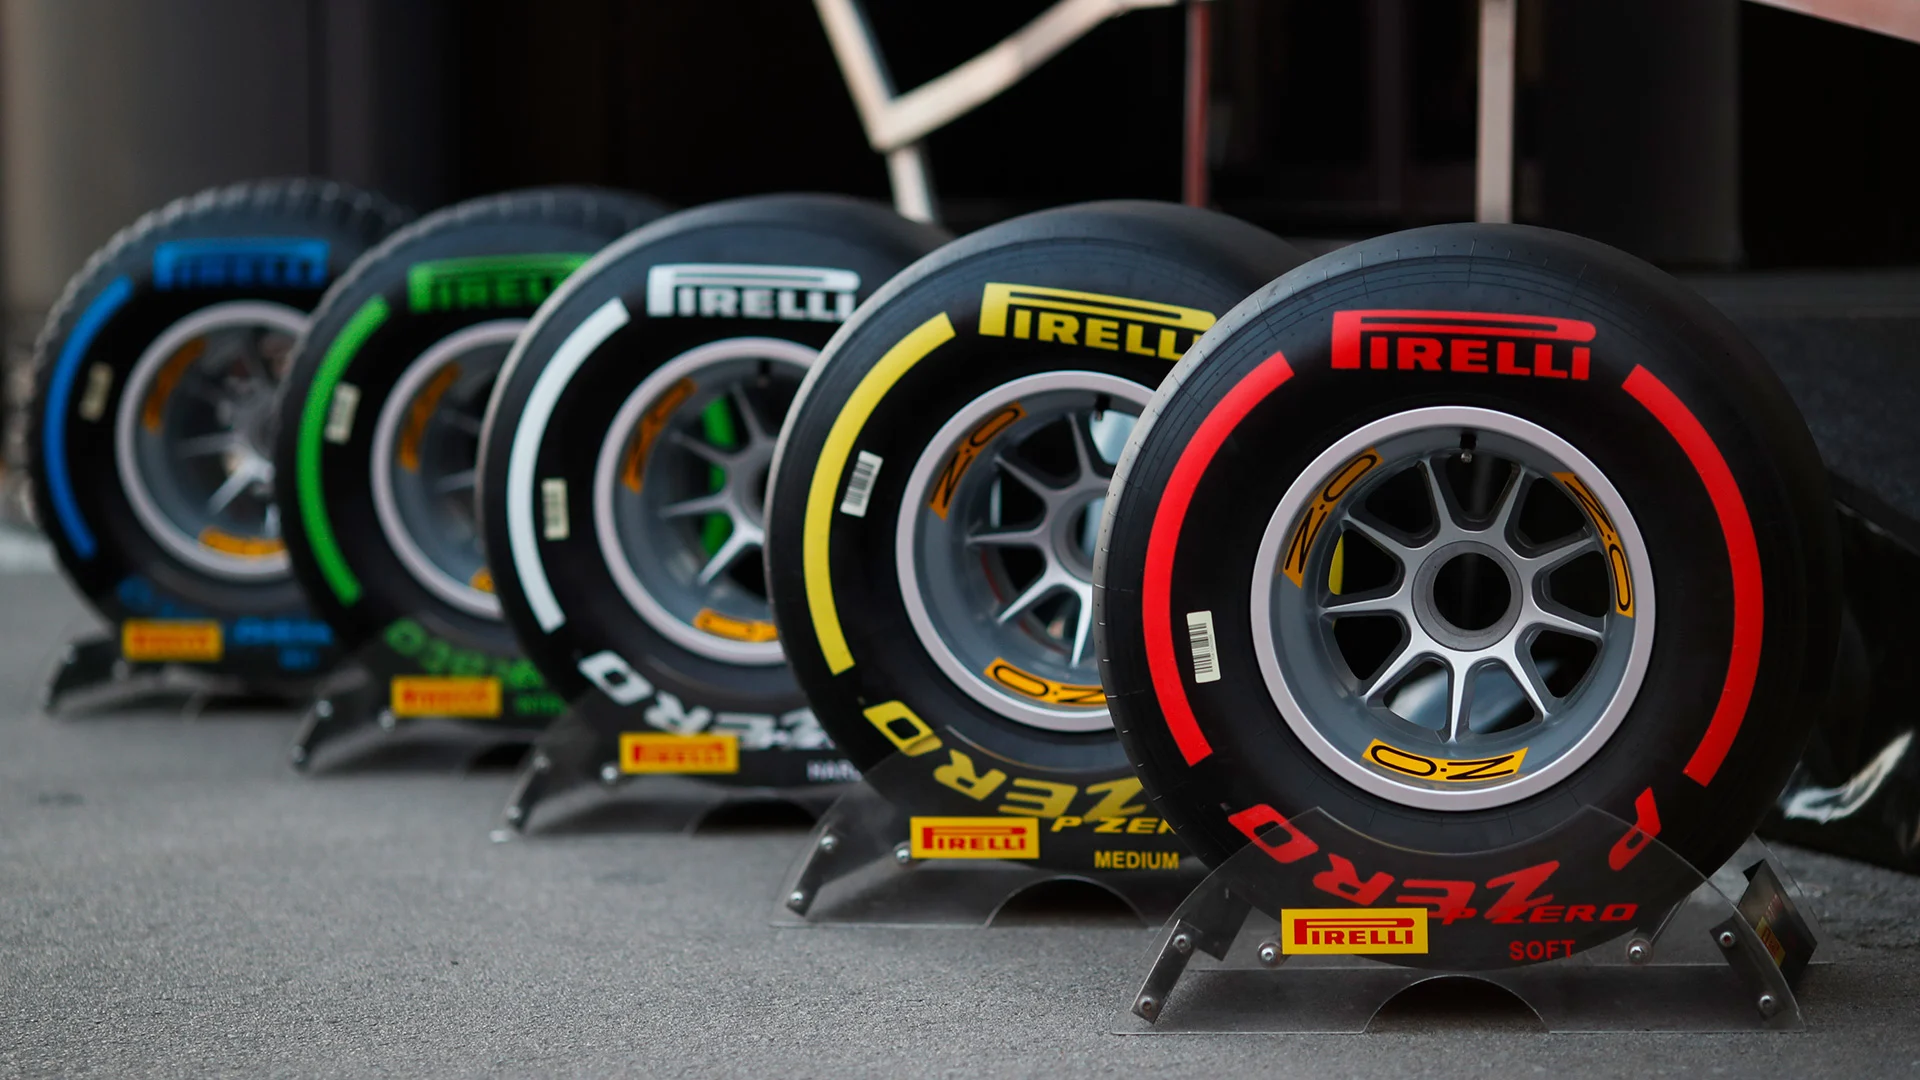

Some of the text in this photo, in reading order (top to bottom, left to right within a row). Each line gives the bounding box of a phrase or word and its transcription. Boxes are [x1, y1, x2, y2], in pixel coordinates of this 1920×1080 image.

[647, 263, 861, 322] PIRELLI
[1331, 309, 1597, 381] PIRELLI
[1094, 816, 1175, 834] ZE
[922, 825, 1027, 851] PIRELLI
[1094, 851, 1179, 869] MEDIUM
[1491, 904, 1638, 924] ZERO
[1294, 917, 1415, 945] PIRELLI
[1509, 940, 1576, 961] SOFT
